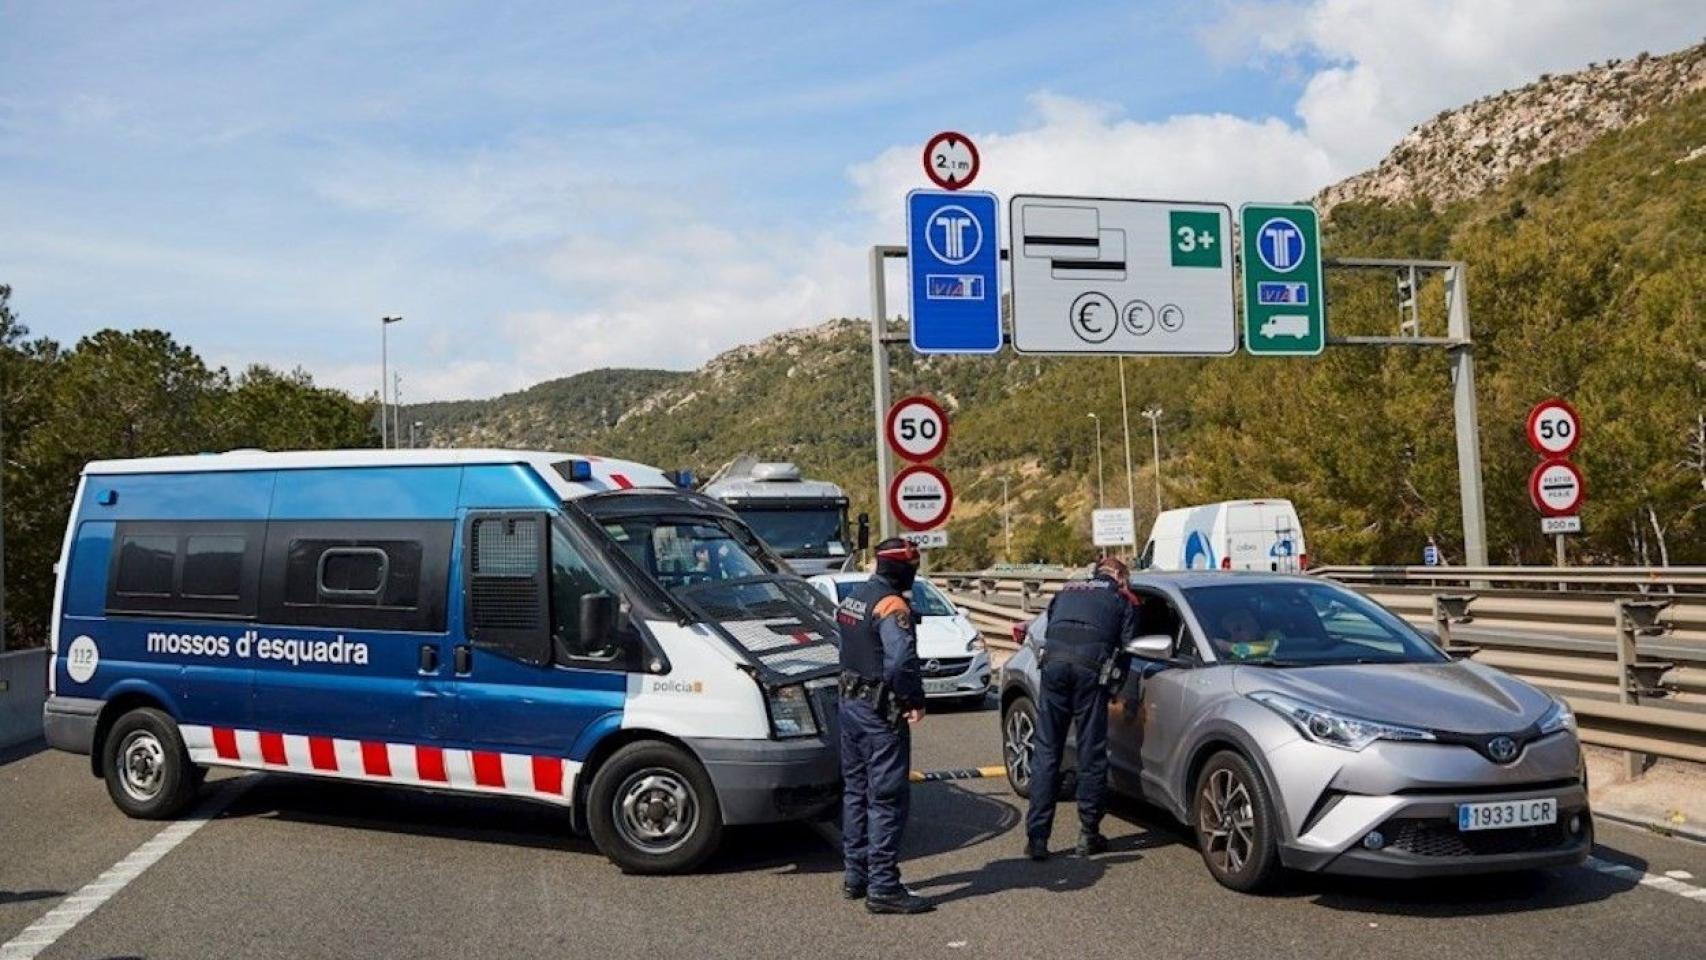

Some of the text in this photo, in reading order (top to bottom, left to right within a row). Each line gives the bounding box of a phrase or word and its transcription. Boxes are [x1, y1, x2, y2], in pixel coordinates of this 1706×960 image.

[1177, 226, 1214, 253] 3+
[901, 418, 936, 441] 50
[1541, 419, 1571, 439] 50
[74, 649, 93, 664] 112
[147, 630, 369, 666] mossos d'esquadra
[653, 679, 692, 694] policia
[1473, 802, 1551, 827] 1933 LCR
